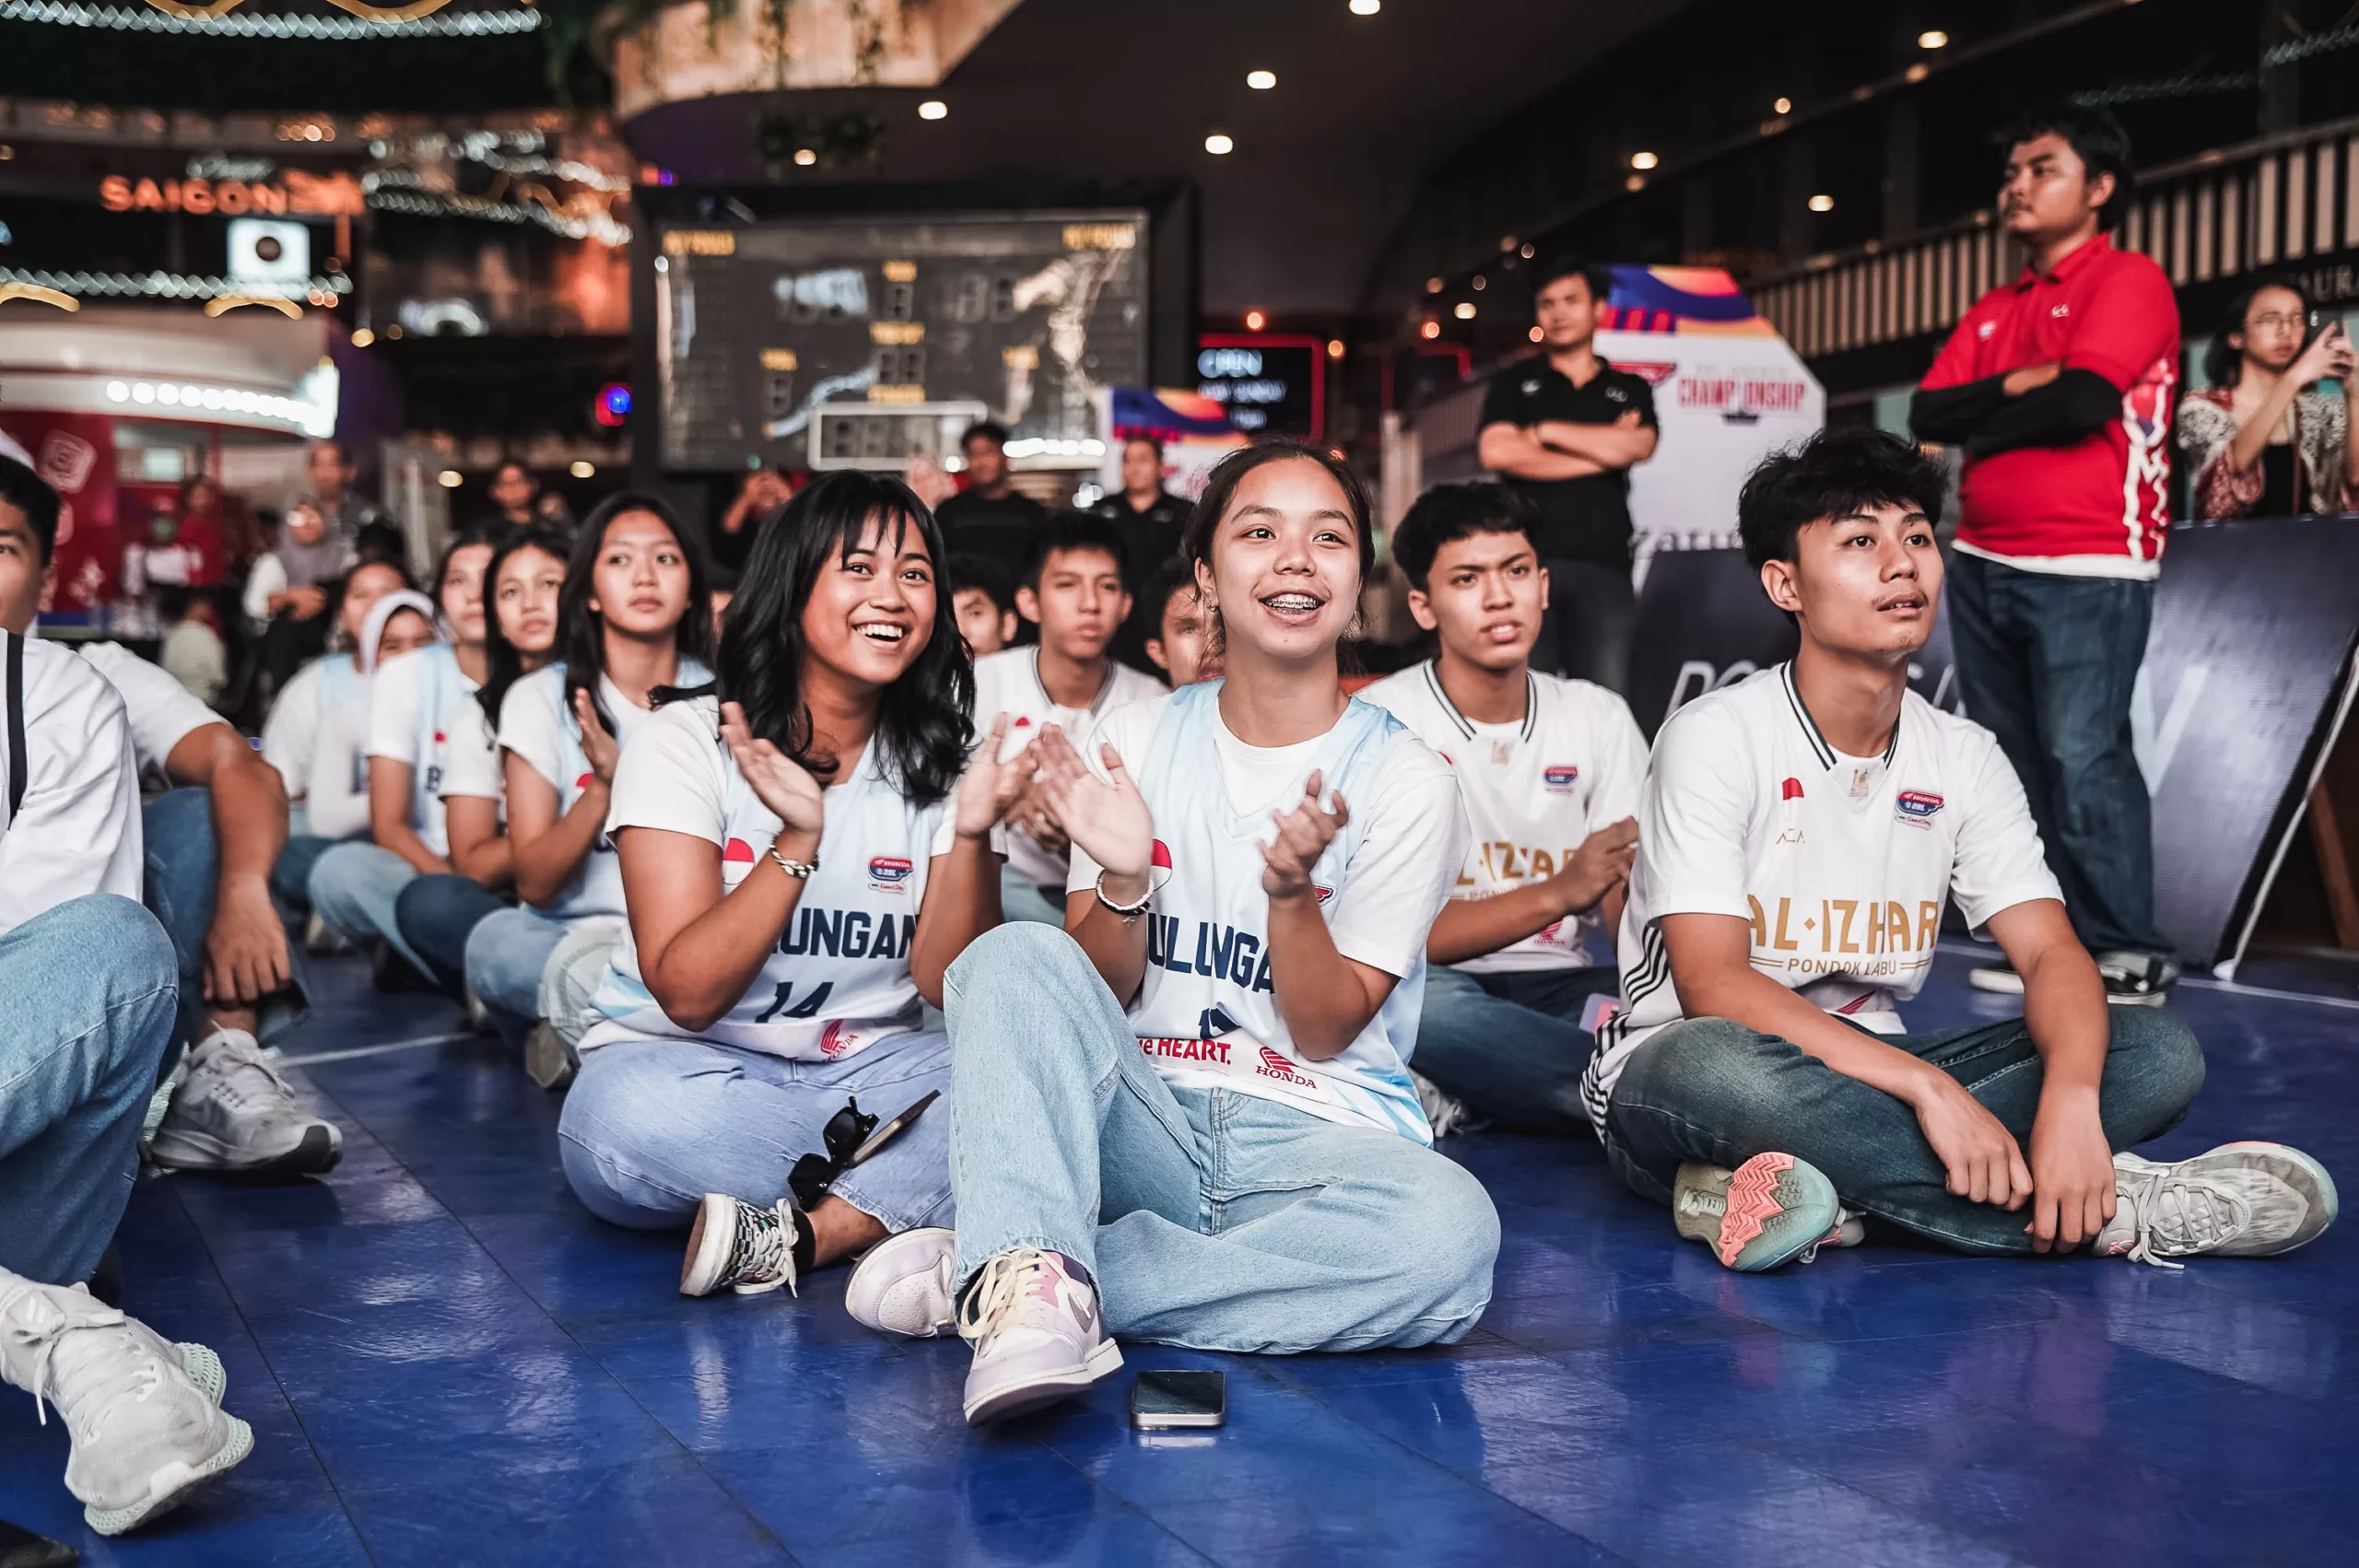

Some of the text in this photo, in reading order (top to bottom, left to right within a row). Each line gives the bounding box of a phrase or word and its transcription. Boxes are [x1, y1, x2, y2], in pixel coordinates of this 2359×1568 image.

[772, 907, 919, 959] UNGAN
[1788, 957, 1896, 977] PONDOK LABU
[755, 981, 834, 1024] 14
[1156, 1037, 1232, 1065] HEART.
[1255, 1065, 1318, 1090] HONDA
